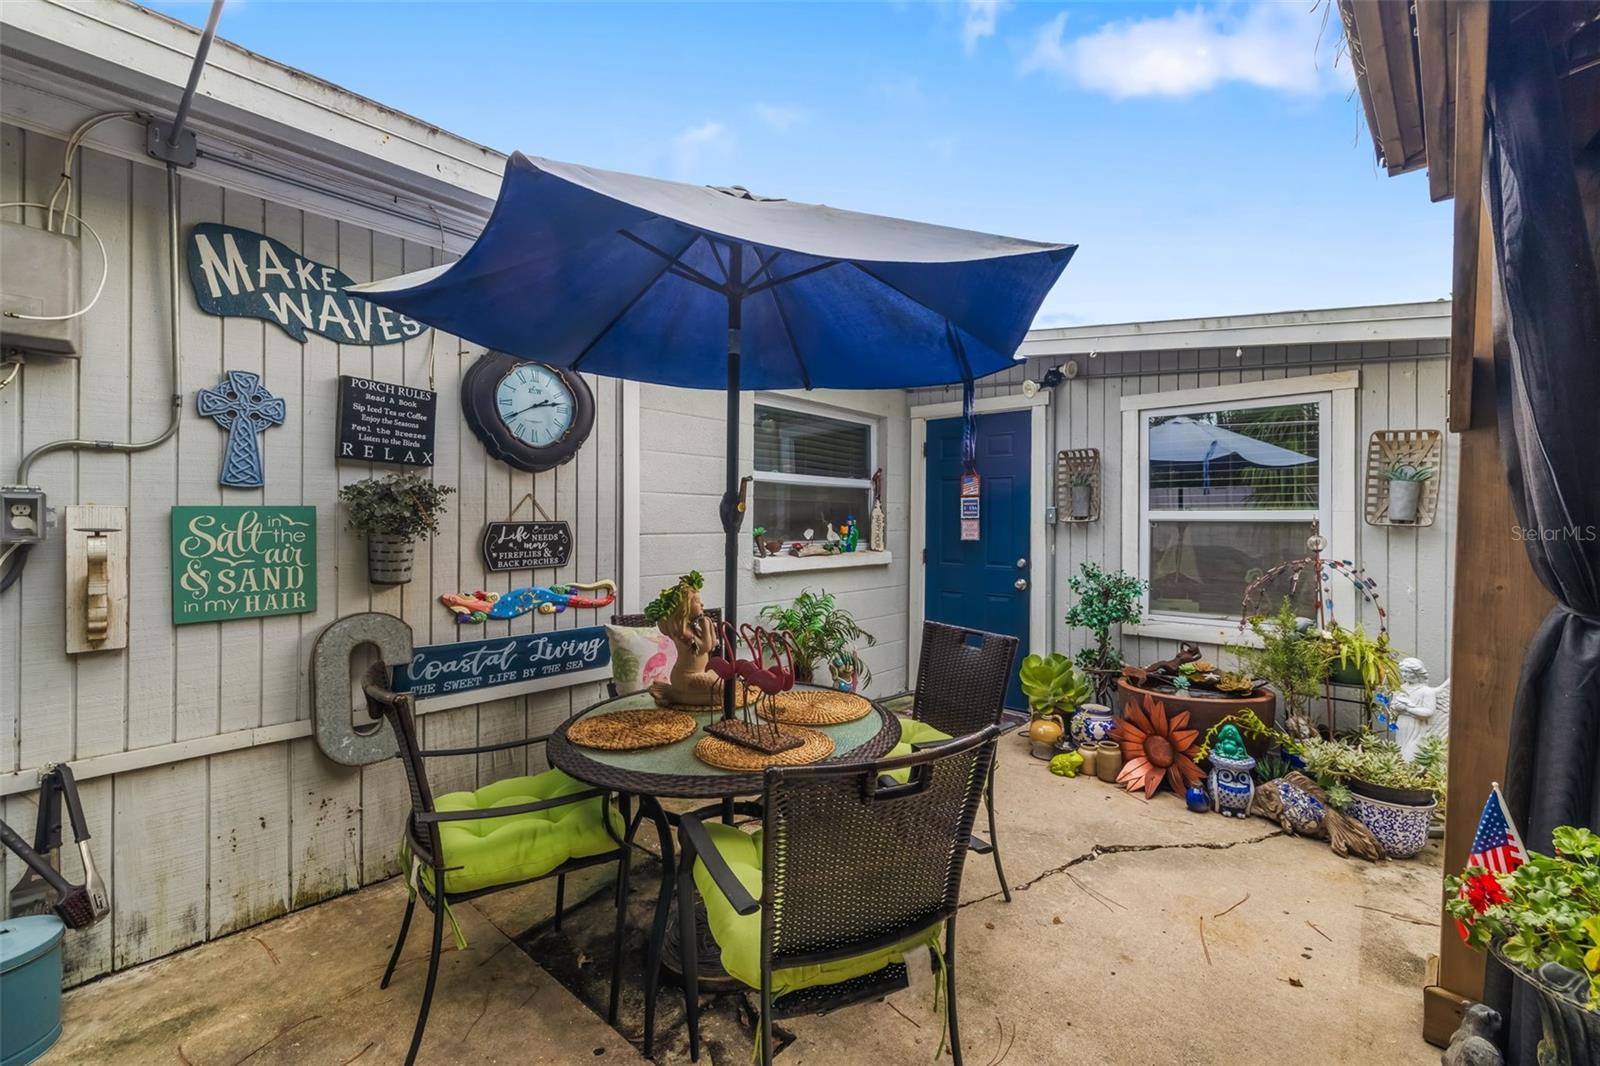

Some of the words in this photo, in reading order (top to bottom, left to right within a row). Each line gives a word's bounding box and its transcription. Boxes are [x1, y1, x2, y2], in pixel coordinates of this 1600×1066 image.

[195, 233, 338, 298] MAKE
[262, 292, 420, 341] WAVES
[351, 378, 394, 394] PORCH
[398, 387, 431, 401] RULES
[366, 393, 385, 402] Read
[398, 399, 417, 408] Book
[352, 402, 365, 412] Sip
[367, 405, 382, 414] Iced
[384, 408, 396, 416] Tea
[407, 412, 428, 421] Coffee
[361, 414, 380, 424] Enjoy
[382, 417, 392, 425] the
[394, 419, 419, 428] Seasons
[352, 424, 371, 432] Feel
[377, 427, 390, 435] the
[395, 430, 426, 439] Breezes
[358, 433, 380, 443] Listen
[391, 438, 401, 446] the
[402, 440, 420, 448] Birds
[342, 442, 432, 464] RELAX
[180, 510, 270, 558] Salt
[268, 515, 281, 527] in
[272, 528, 306, 543] the
[498, 526, 530, 544] Life
[532, 533, 558, 541] NEEDS
[264, 544, 310, 566] air
[499, 550, 541, 559] FIREFLIES
[543, 548, 552, 557] &
[524, 541, 548, 549] more
[498, 560, 520, 568] BACK
[522, 557, 559, 566] PORCHES
[180, 559, 211, 600] &
[217, 566, 304, 594] SAND
[184, 601, 199, 612] in
[204, 599, 239, 614] my
[245, 592, 306, 612] HAIR
[407, 641, 517, 681] Coastal
[528, 636, 605, 662] Living
[410, 683, 436, 694] THE
[443, 677, 482, 692] SWEET
[488, 671, 516, 683] LIFE
[523, 668, 537, 678] BY
[542, 664, 561, 674] THE
[565, 660, 584, 670] SEA
